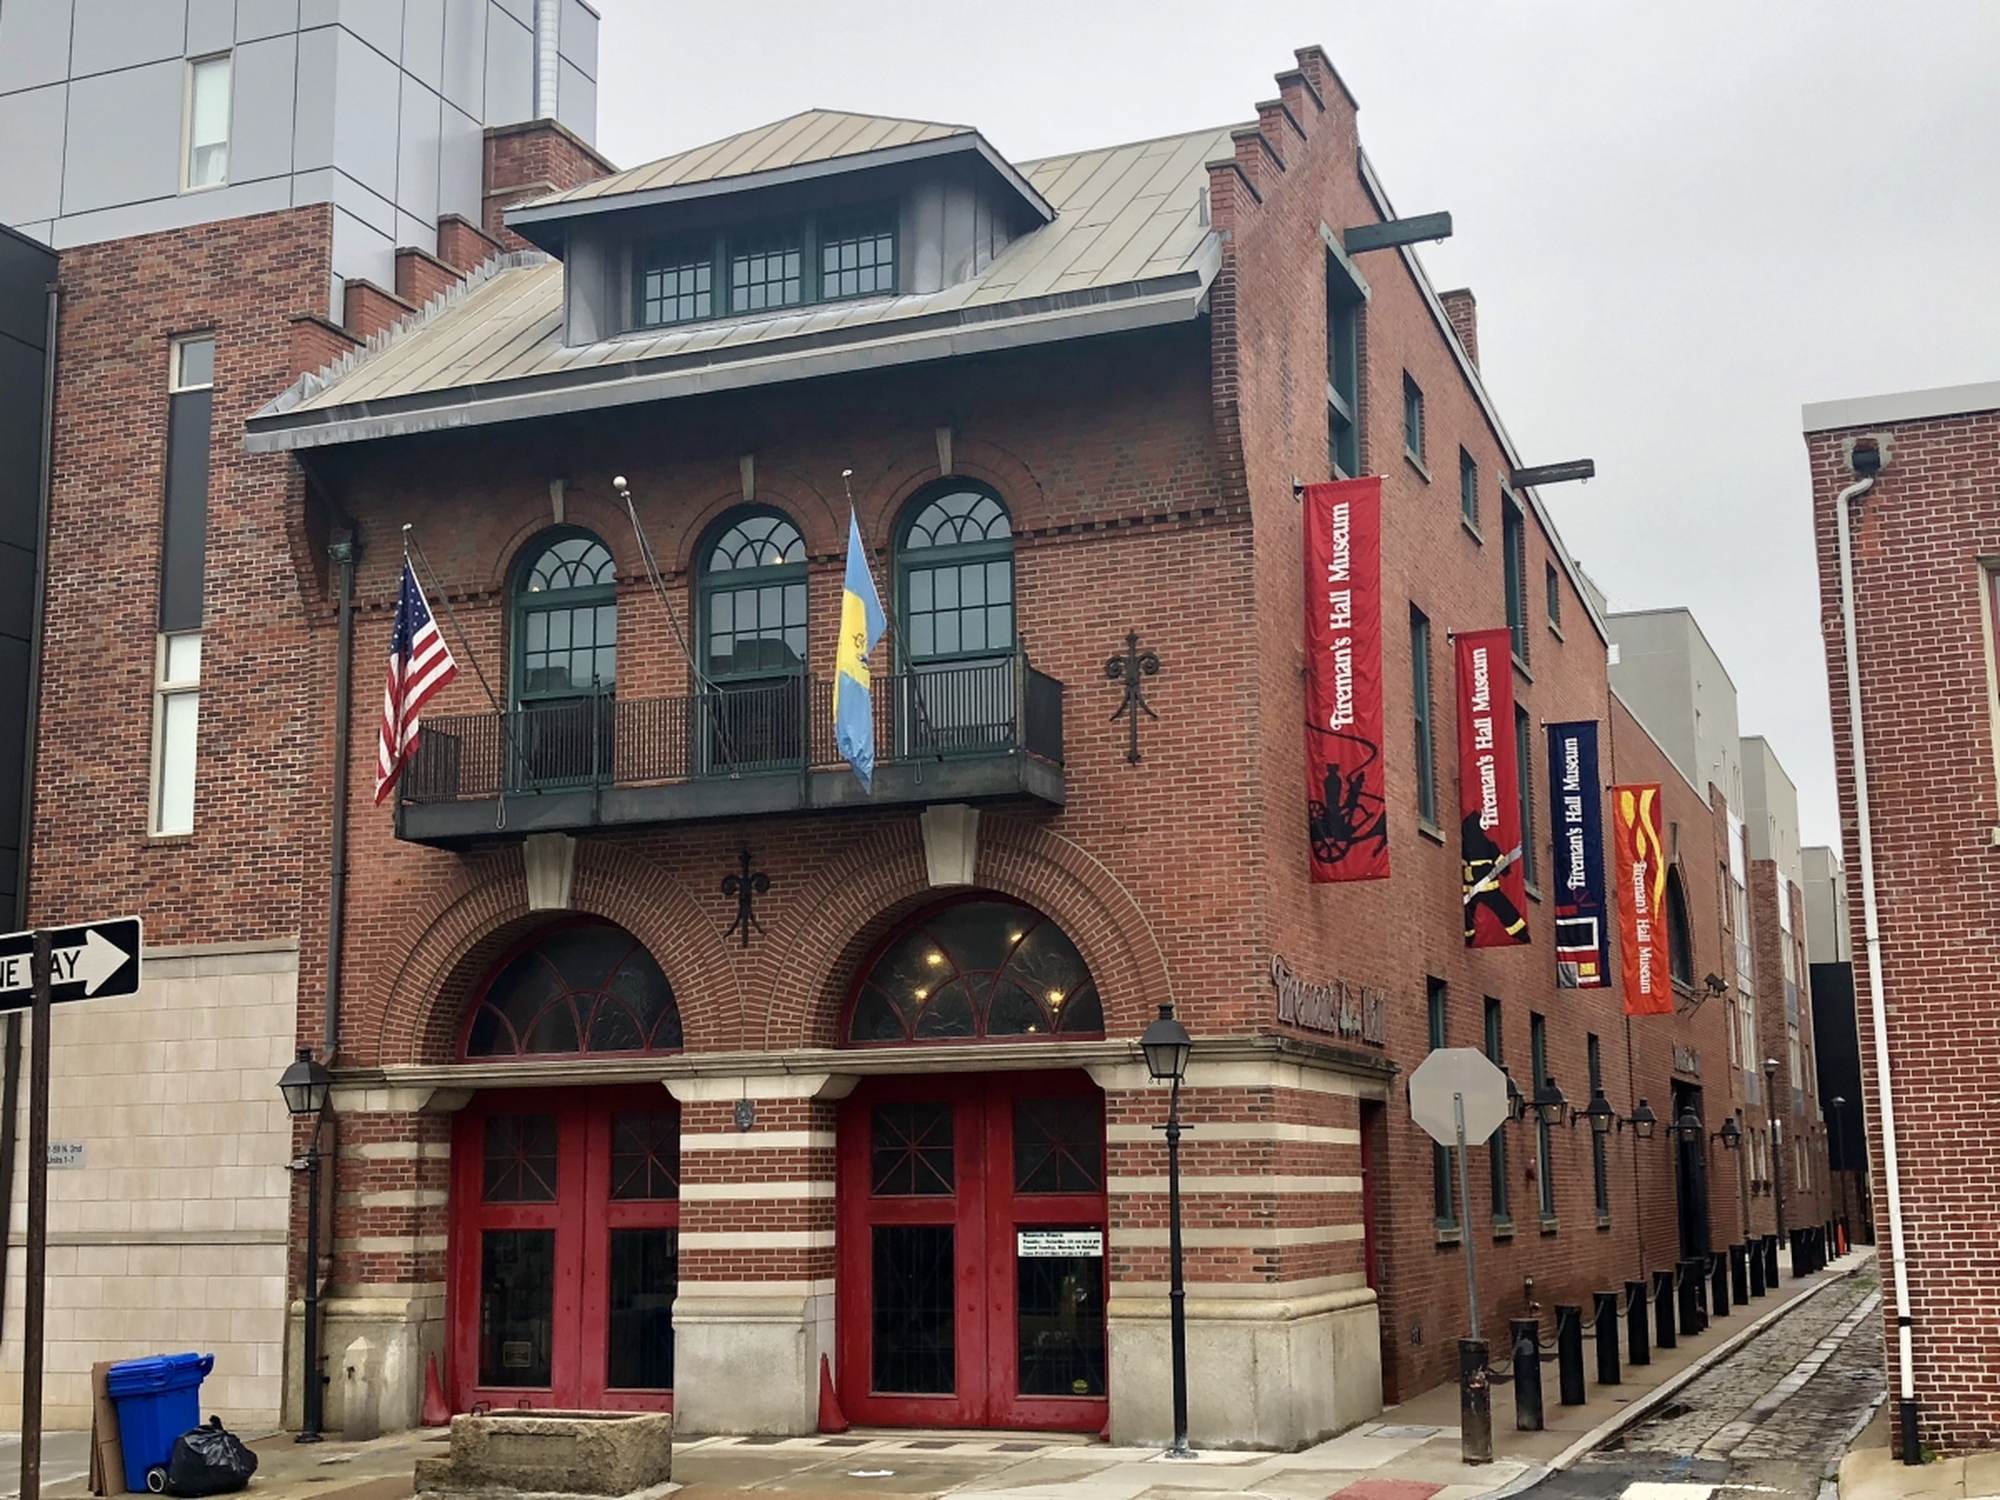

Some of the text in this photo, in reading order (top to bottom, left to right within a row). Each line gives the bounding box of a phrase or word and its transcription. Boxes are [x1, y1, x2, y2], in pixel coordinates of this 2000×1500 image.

[1328, 502, 1354, 731] Fireman's Hall Museum
[1472, 648, 1498, 830] Fireman's Hall Museum
[1563, 737, 1586, 891] Fireman's Hall Museum
[1632, 859, 1652, 994] Fireman's Hall Museum
